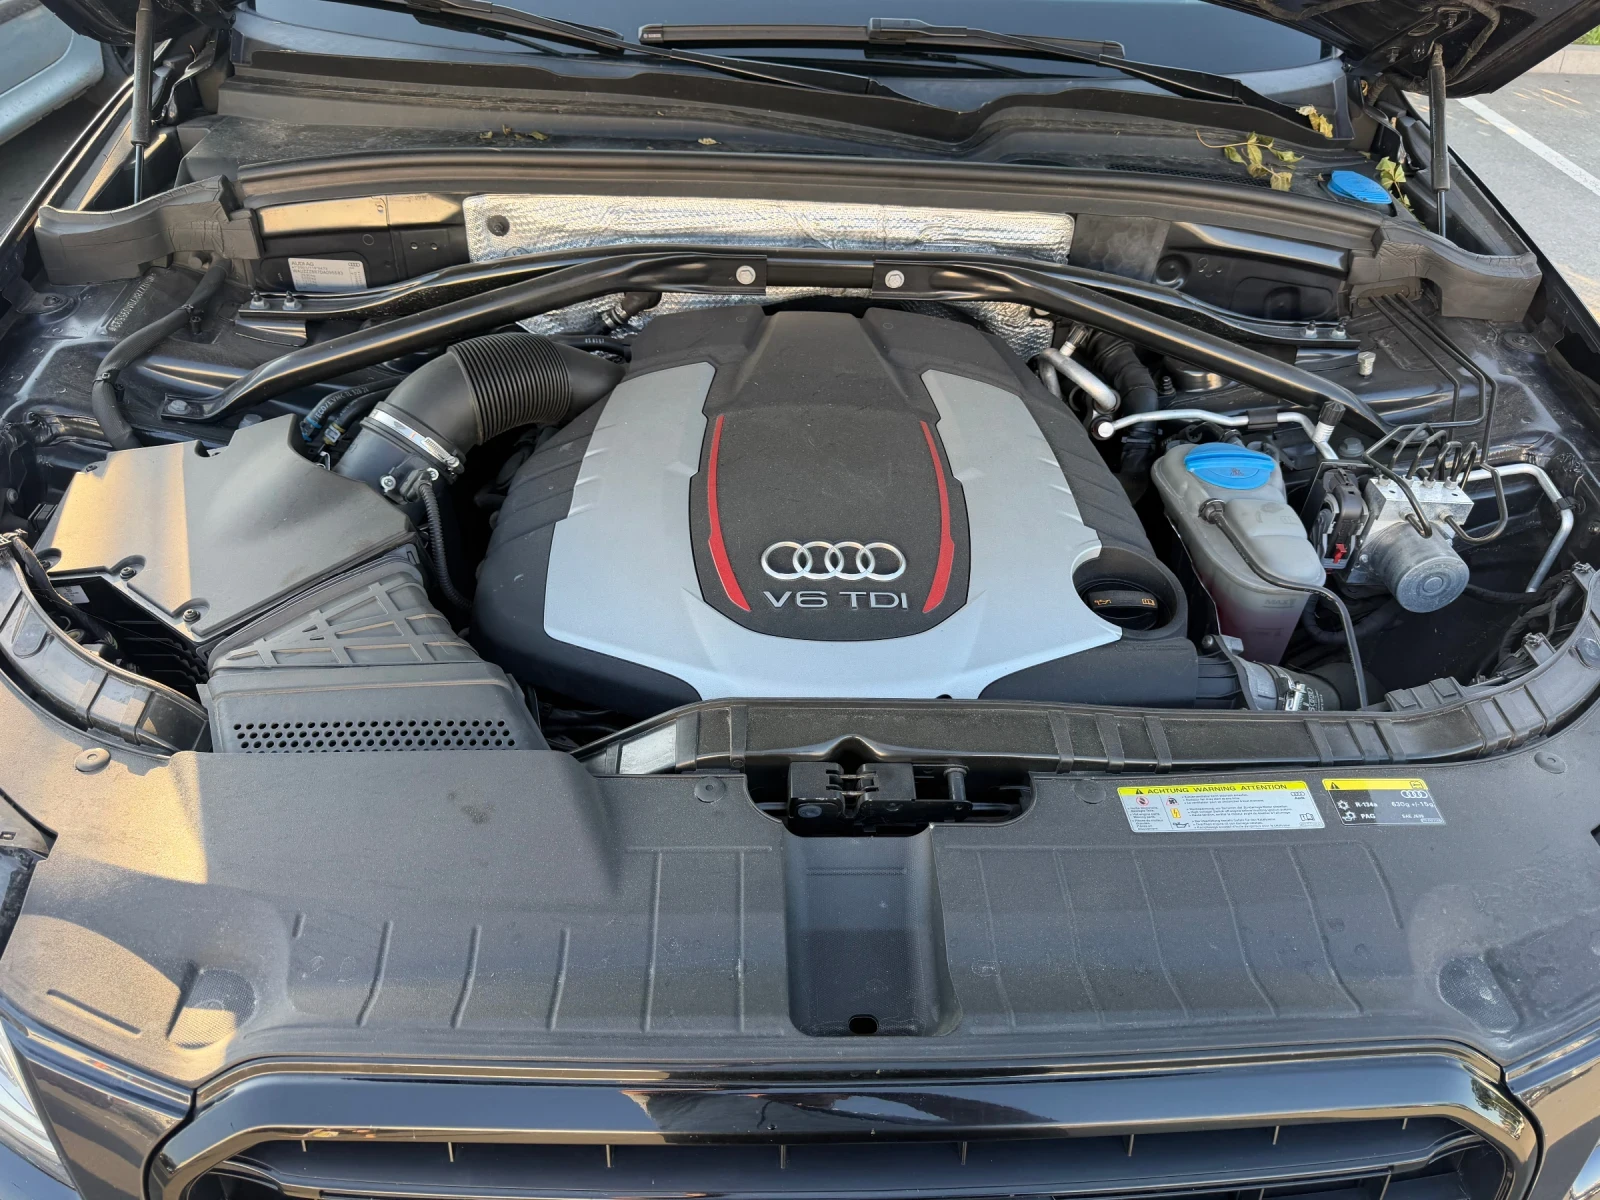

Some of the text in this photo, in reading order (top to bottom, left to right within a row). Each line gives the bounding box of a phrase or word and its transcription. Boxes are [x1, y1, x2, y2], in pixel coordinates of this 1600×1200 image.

[763, 590, 908, 609] V6 TDI
[1241, 783, 1288, 791] ATTENTION
